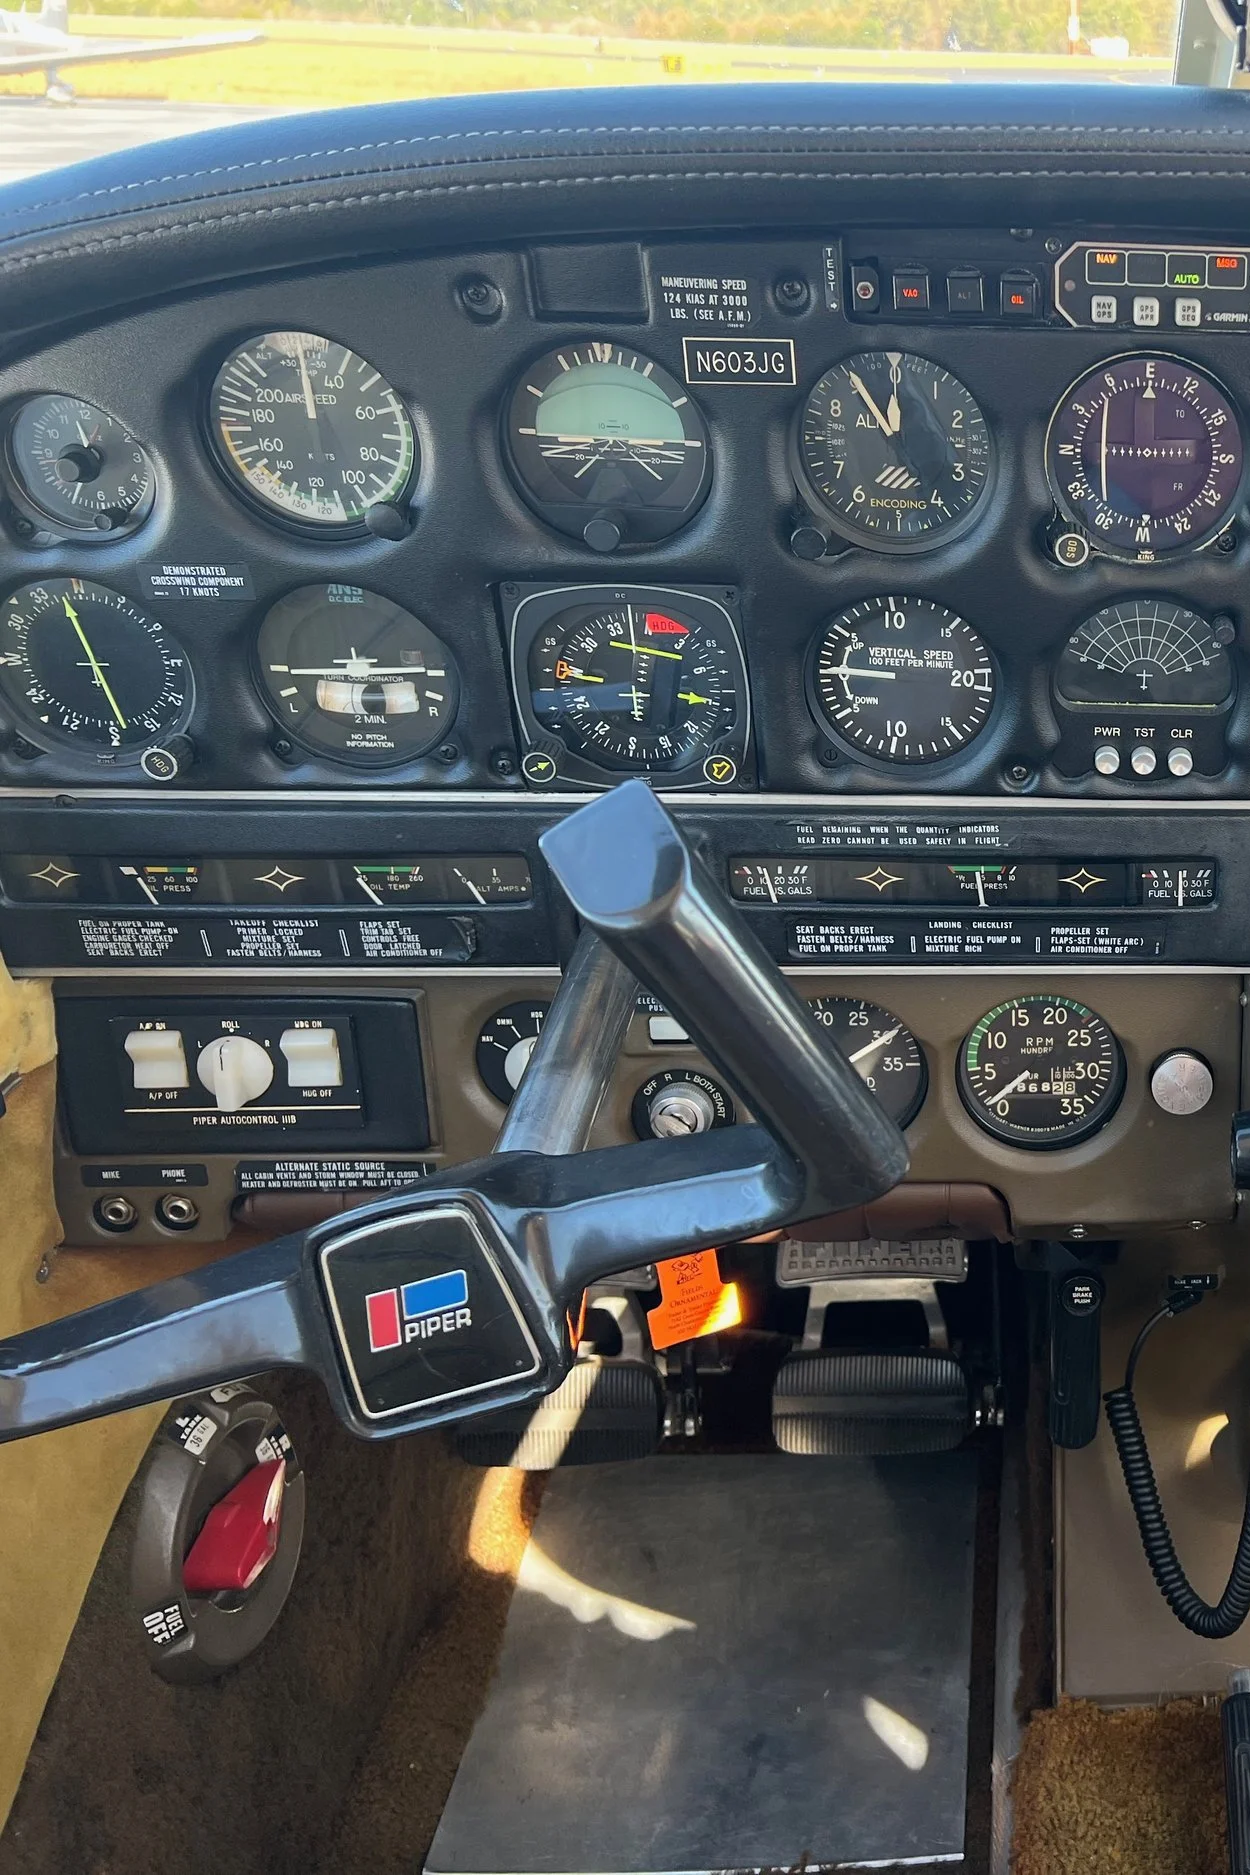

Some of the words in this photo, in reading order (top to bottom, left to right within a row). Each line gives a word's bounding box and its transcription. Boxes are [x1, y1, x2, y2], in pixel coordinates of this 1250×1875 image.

[1096, 254, 1117, 263] NAV
[1216, 259, 1237, 268] MSG
[826, 248, 835, 291] TEST
[662, 277, 718, 290] MANEUVERING
[722, 279, 746, 290] SPEED
[1174, 275, 1199, 284] AUTO
[664, 293, 681, 304] 124
[686, 294, 705, 305] KIAS
[709, 295, 719, 305] AT
[722, 295, 747, 306] 3000
[671, 308, 688, 319] LBS.
[693, 309, 714, 321] (SEE
[718, 310, 751, 322] A.F.M.)
[1214, 314, 1248, 323] GARMIN
[697, 351, 785, 373] N603JG
[256, 389, 283, 403] 200
[871, 499, 926, 509] ENCODING
[163, 566, 226, 575] DEMONSTRATED
[152, 577, 196, 585] CROSSWIND
[198, 577, 244, 586] COMPONENT
[180, 587, 189, 595] 17
[192, 588, 220, 596] KNOTS
[652, 622, 675, 630] HDG
[853, 642, 864, 650] UP
[869, 647, 916, 658] VERTICAL
[924, 650, 953, 660] SPEED
[869, 657, 883, 665] 100
[885, 658, 905, 666] FEET
[908, 659, 924, 667] PER
[927, 660, 953, 669] MINUTE
[1094, 727, 1120, 737] PWR
[1134, 728, 1155, 737] TST
[1171, 729, 1192, 738] CLR
[975, 837, 999, 845] FLIGHT
[796, 926, 814, 934] SEAT
[820, 926, 845, 934] BACKS
[850, 926, 874, 934] ERECT
[1051, 927, 1090, 935] PROPELLER
[1051, 936, 1090, 944] FLAPS-SET
[1094, 937, 1121, 946] (WHITE
[1124, 938, 1144, 946] ARC)
[799, 944, 817, 952] FUEL
[867, 944, 887, 952] TANK
[1051, 945, 1063, 953] AIR
[1066, 946, 1112, 954] CONDITIONER
[1115, 946, 1128, 954] OFF
[1027, 1038, 1053, 1046] RPM
[694, 1075, 716, 1093] BOTH
[713, 1092, 725, 1118] START
[193, 1116, 217, 1125] PIPER
[221, 1115, 279, 1124] AUTOCONTROL
[282, 1115, 296, 1123] IIIB
[276, 1163, 319, 1171] ALTERNATE
[354, 1162, 385, 1170] SOURCE
[102, 1171, 120, 1179] MIKE
[162, 1169, 185, 1177] PHONE
[404, 1308, 472, 1344] PIPER
[165, 1605, 184, 1635] FUEL
[143, 1611, 170, 1644] OFF
